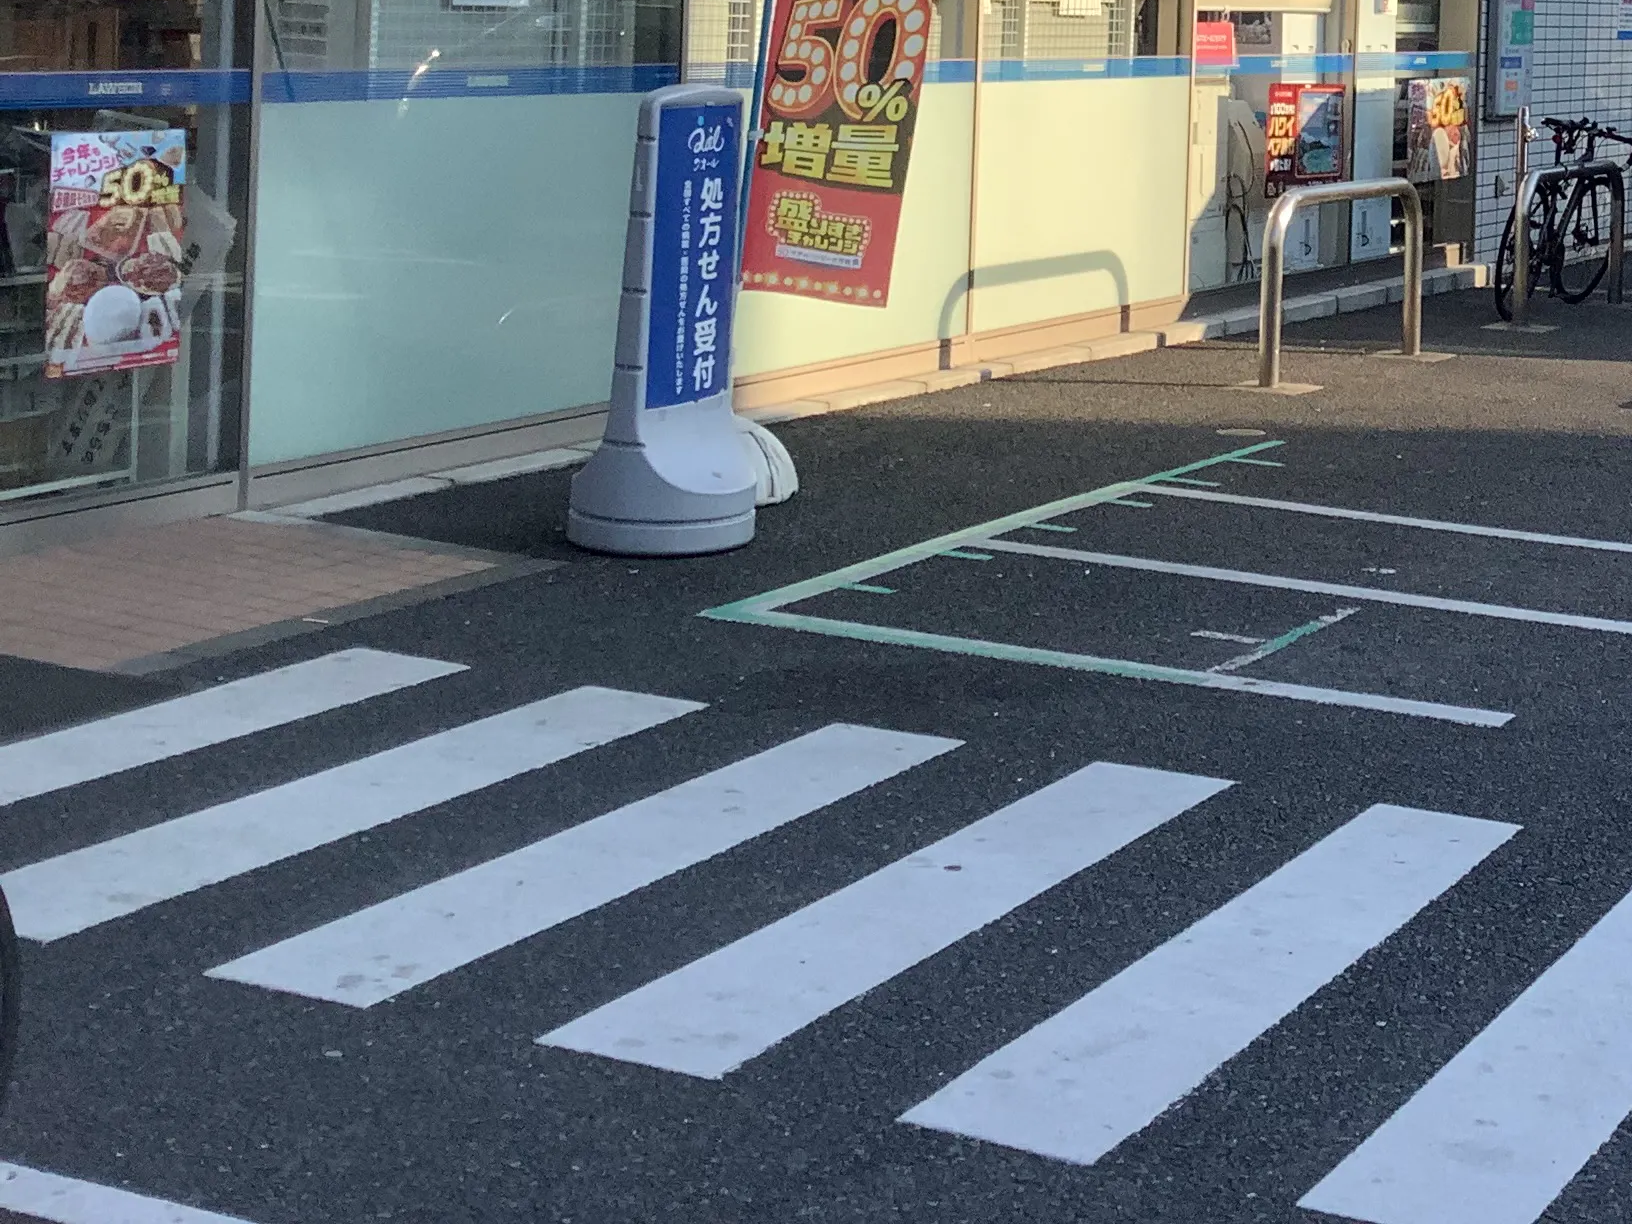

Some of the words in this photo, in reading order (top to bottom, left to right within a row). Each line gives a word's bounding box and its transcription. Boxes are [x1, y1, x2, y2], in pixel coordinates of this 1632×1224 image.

[761, 121, 899, 188] 増量
[775, 198, 863, 241] 盛りすぎ
[693, 177, 724, 392] 処方せん受付
